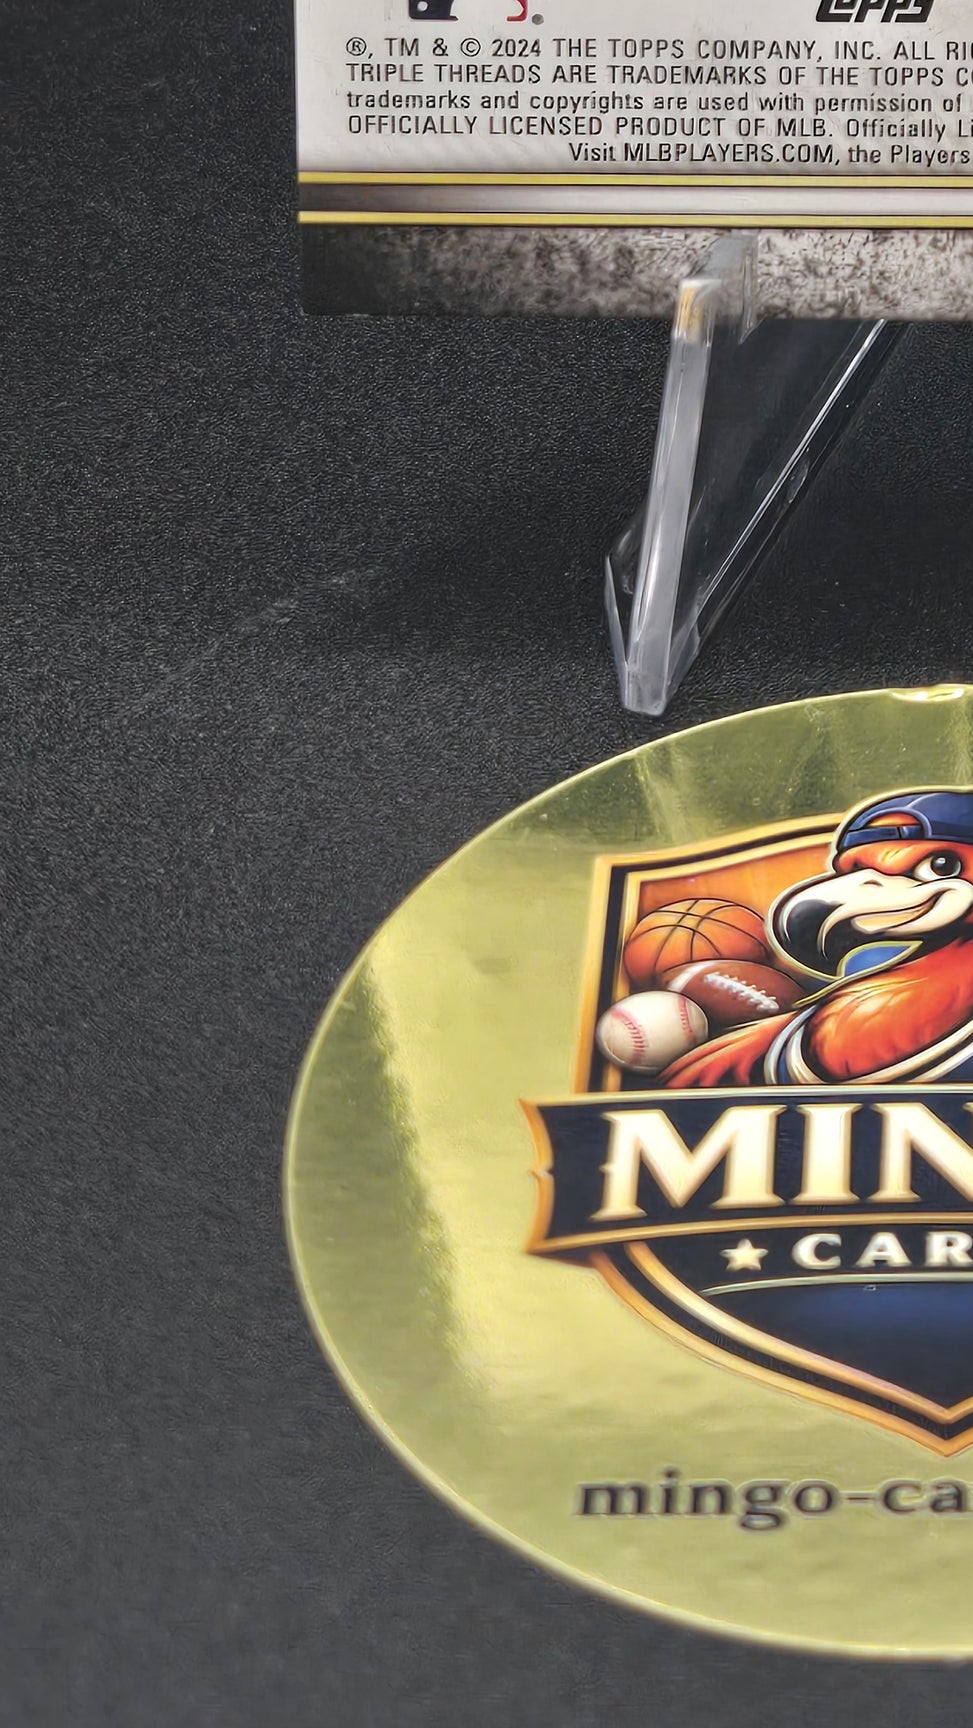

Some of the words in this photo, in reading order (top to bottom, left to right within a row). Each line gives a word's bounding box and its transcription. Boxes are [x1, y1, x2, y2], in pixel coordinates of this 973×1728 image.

[385, 38, 418, 56] TM
[433, 38, 448, 56] &
[492, 39, 541, 57] 2024
[553, 38, 596, 57] THE
[608, 39, 683, 59] TOPPS
[698, 41, 822, 62] COMPANY,
[835, 41, 881, 60] INC.
[894, 40, 935, 60] ALL
[346, 63, 423, 82] TRIPLE
[434, 64, 540, 83] THREADS
[552, 64, 596, 83] ARE
[607, 65, 766, 85] TRADEMARKS
[779, 66, 806, 85] OF
[816, 67, 859, 85] THE
[869, 66, 943, 86] TOPPS
[347, 90, 470, 109] trademarks
[481, 90, 519, 110] and
[530, 90, 643, 114] copyrights
[654, 97, 687, 110] are
[699, 92, 748, 111] used
[759, 93, 803, 111] with
[815, 98, 931, 115] permission
[943, 94, 961, 112] of
[569, 143, 616, 162] Visit
[623, 143, 839, 164] MLBPLAYERS.COM,
[848, 145, 881, 163] the
[891, 145, 970, 167] Players
